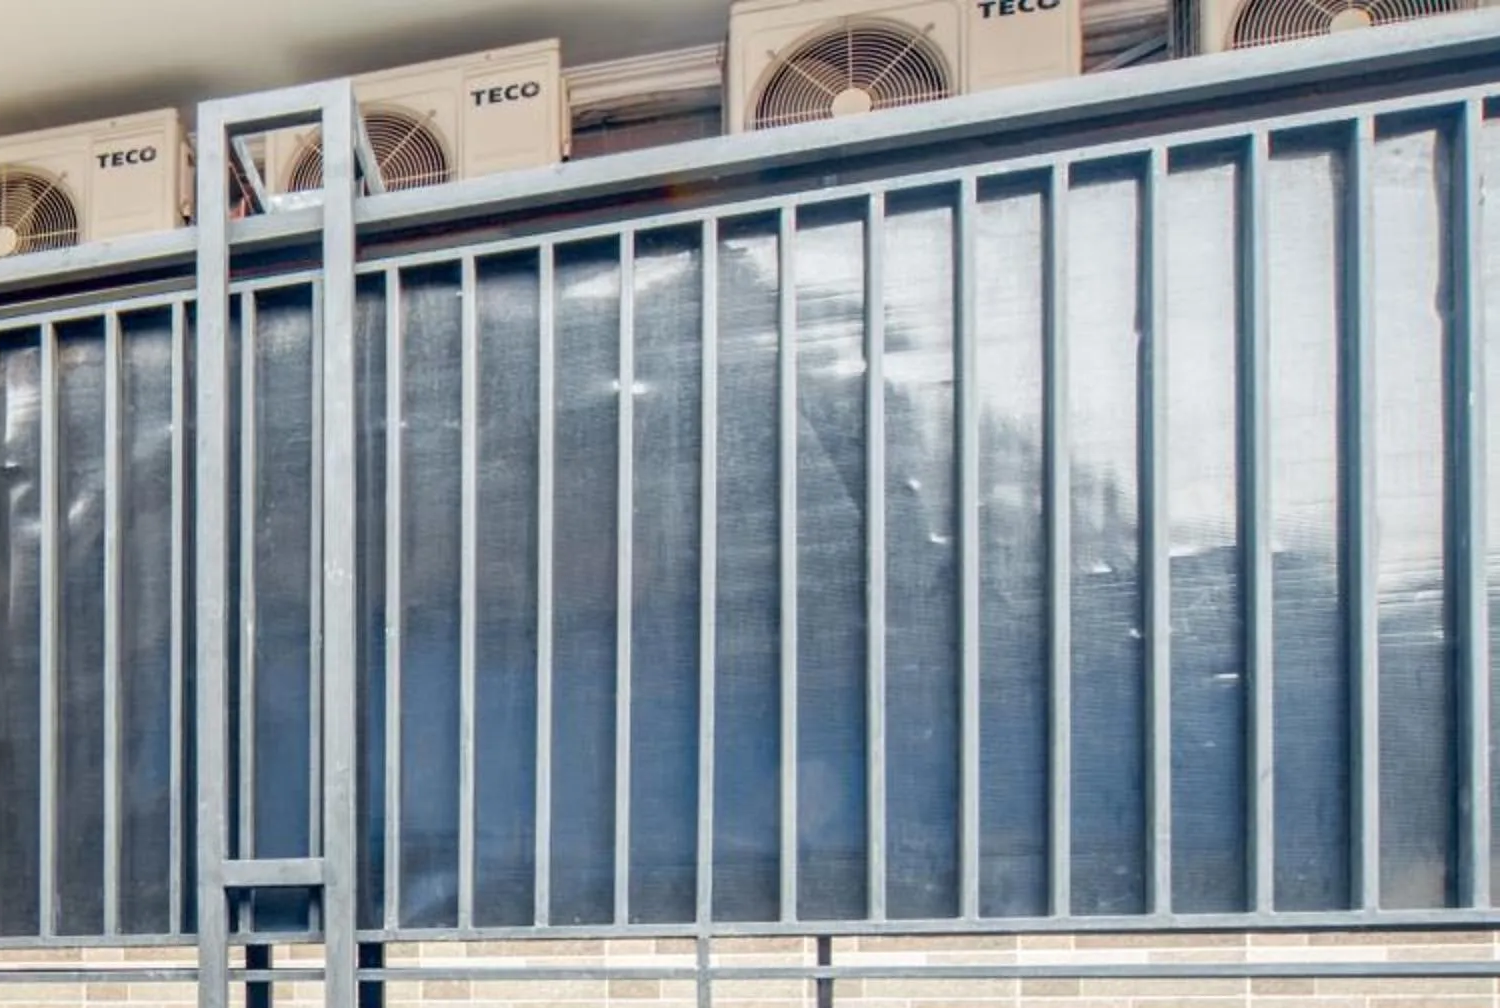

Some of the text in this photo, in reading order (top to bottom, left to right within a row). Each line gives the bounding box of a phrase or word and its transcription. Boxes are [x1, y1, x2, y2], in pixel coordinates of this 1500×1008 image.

[977, 0, 1060, 18] TECO
[470, 81, 540, 106] TECO
[96, 145, 157, 168] TECO
